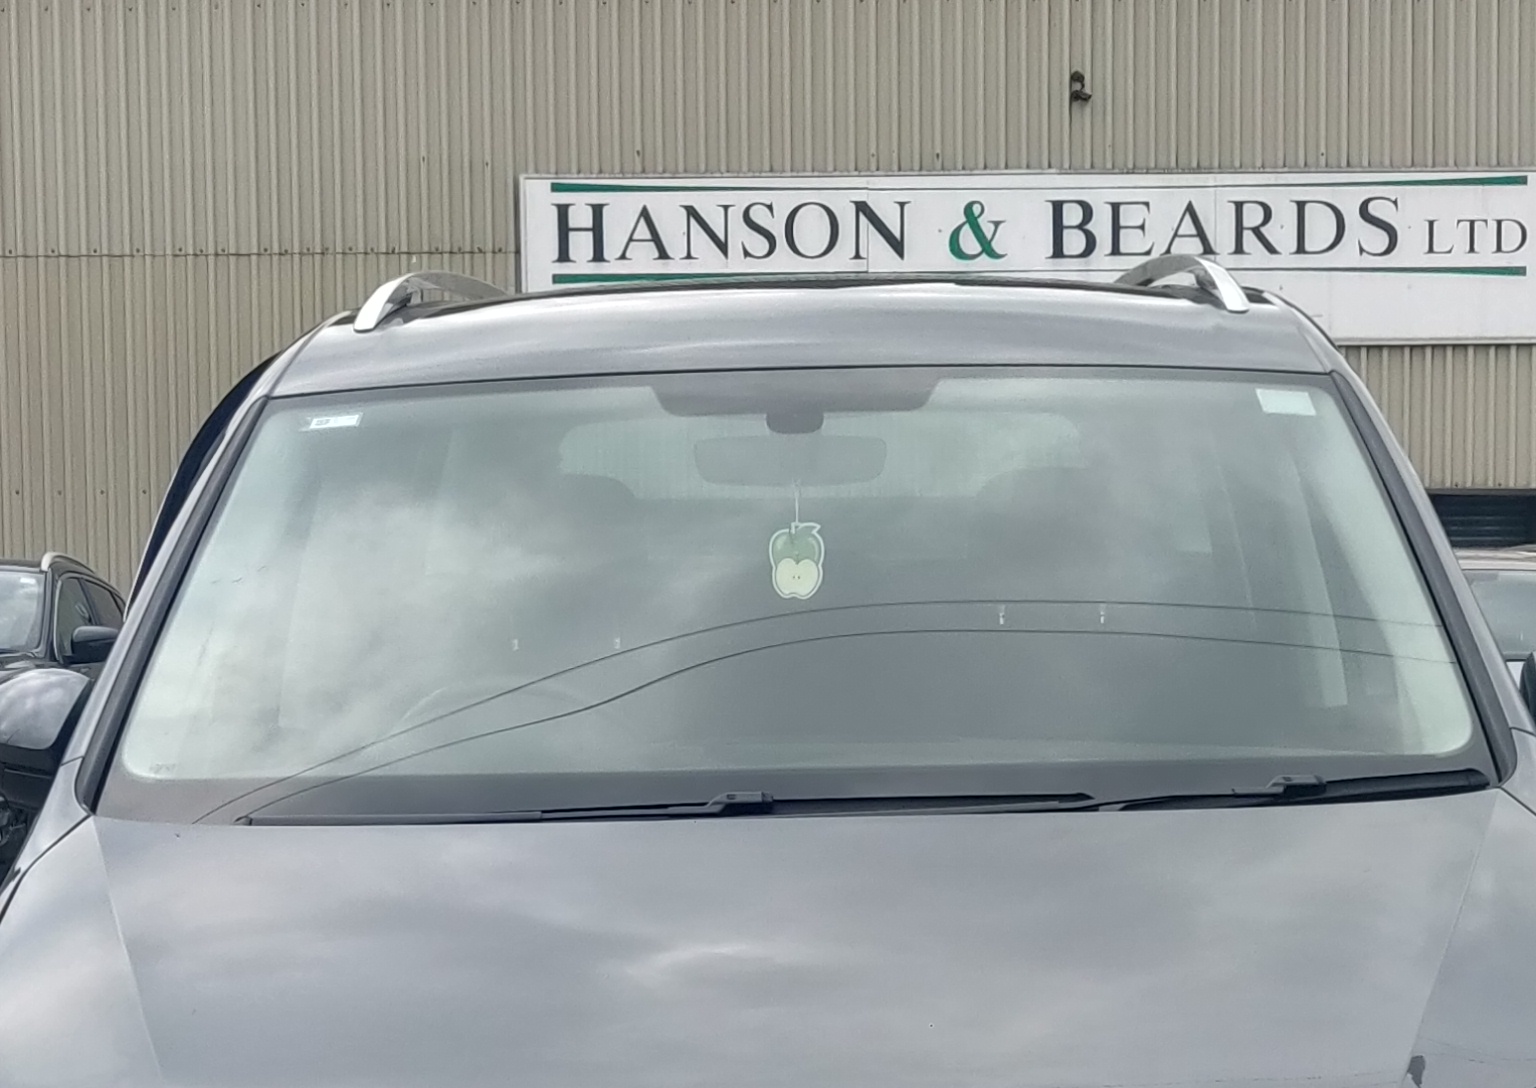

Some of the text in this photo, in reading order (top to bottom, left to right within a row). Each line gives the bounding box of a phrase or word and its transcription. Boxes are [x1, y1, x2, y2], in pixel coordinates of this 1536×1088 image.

[550, 196, 1528, 264] HANSON & BEARDS LTD
